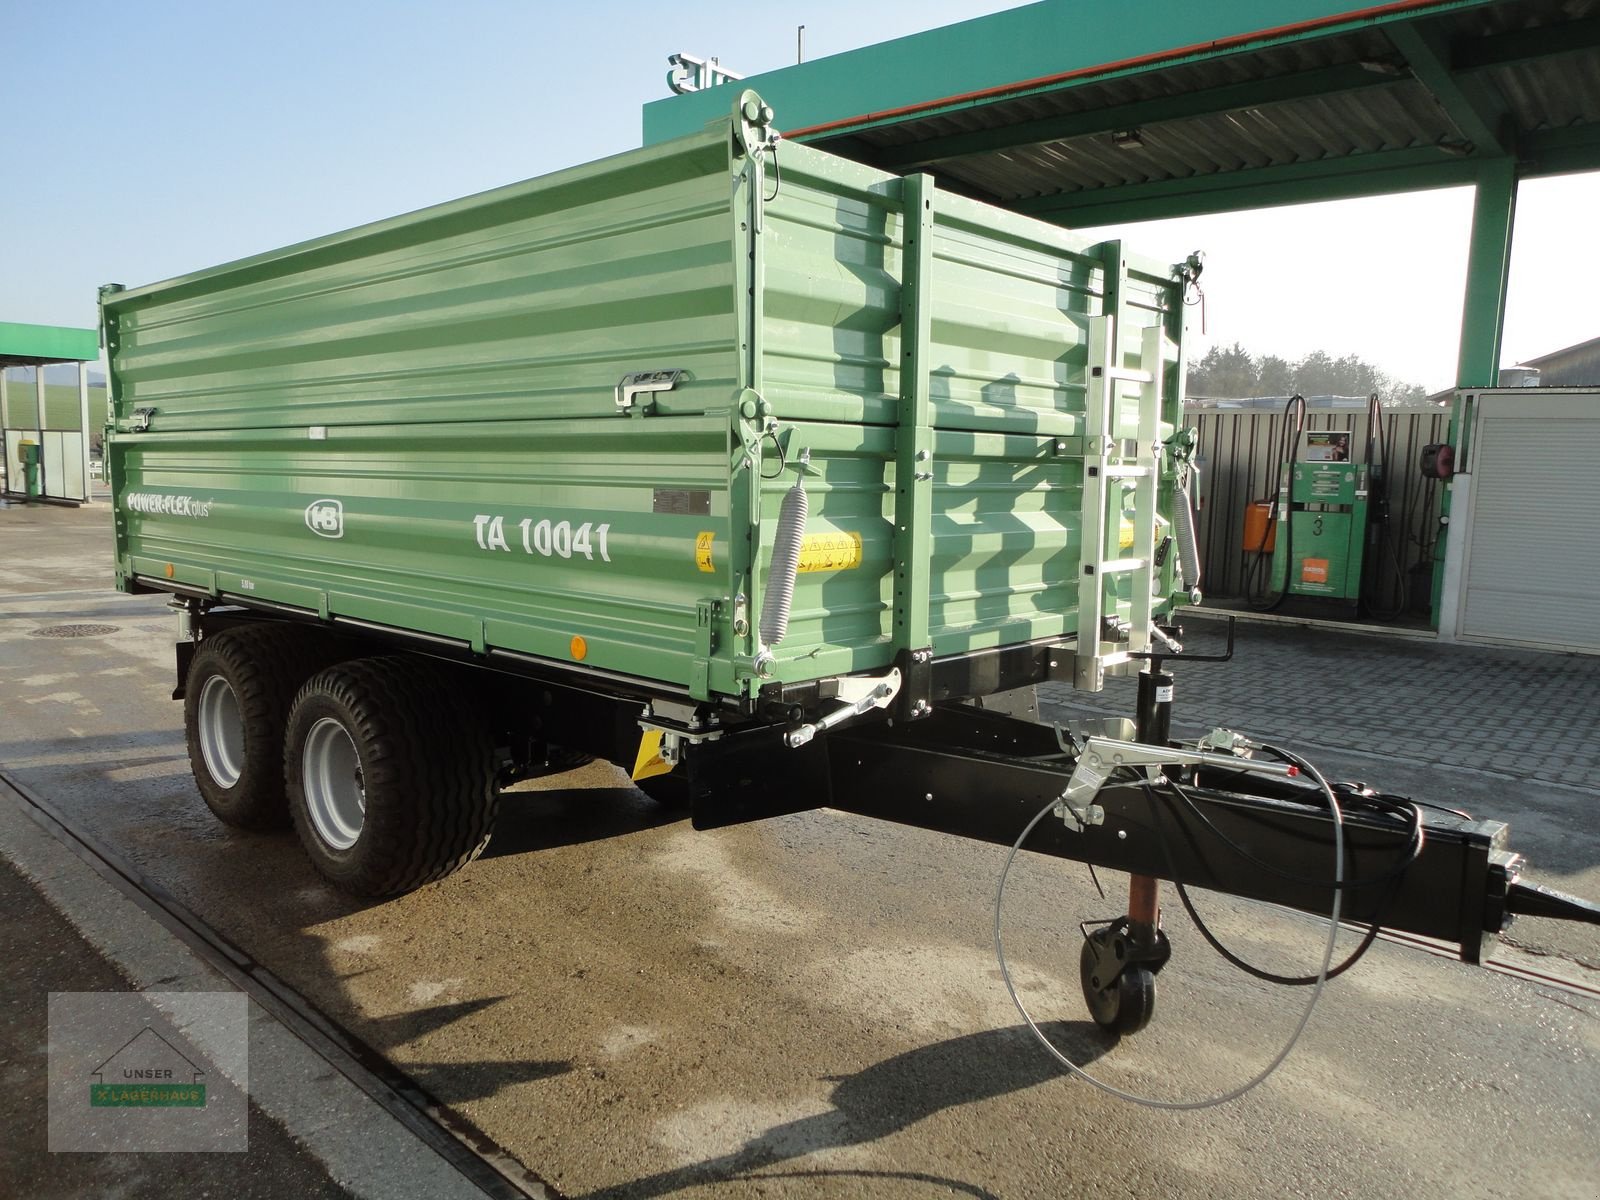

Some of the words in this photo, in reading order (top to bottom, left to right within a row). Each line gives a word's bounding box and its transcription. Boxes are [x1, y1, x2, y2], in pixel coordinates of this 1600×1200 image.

[473, 514, 510, 552] TA
[519, 518, 612, 563] 10041
[1312, 519, 1323, 537] 3
